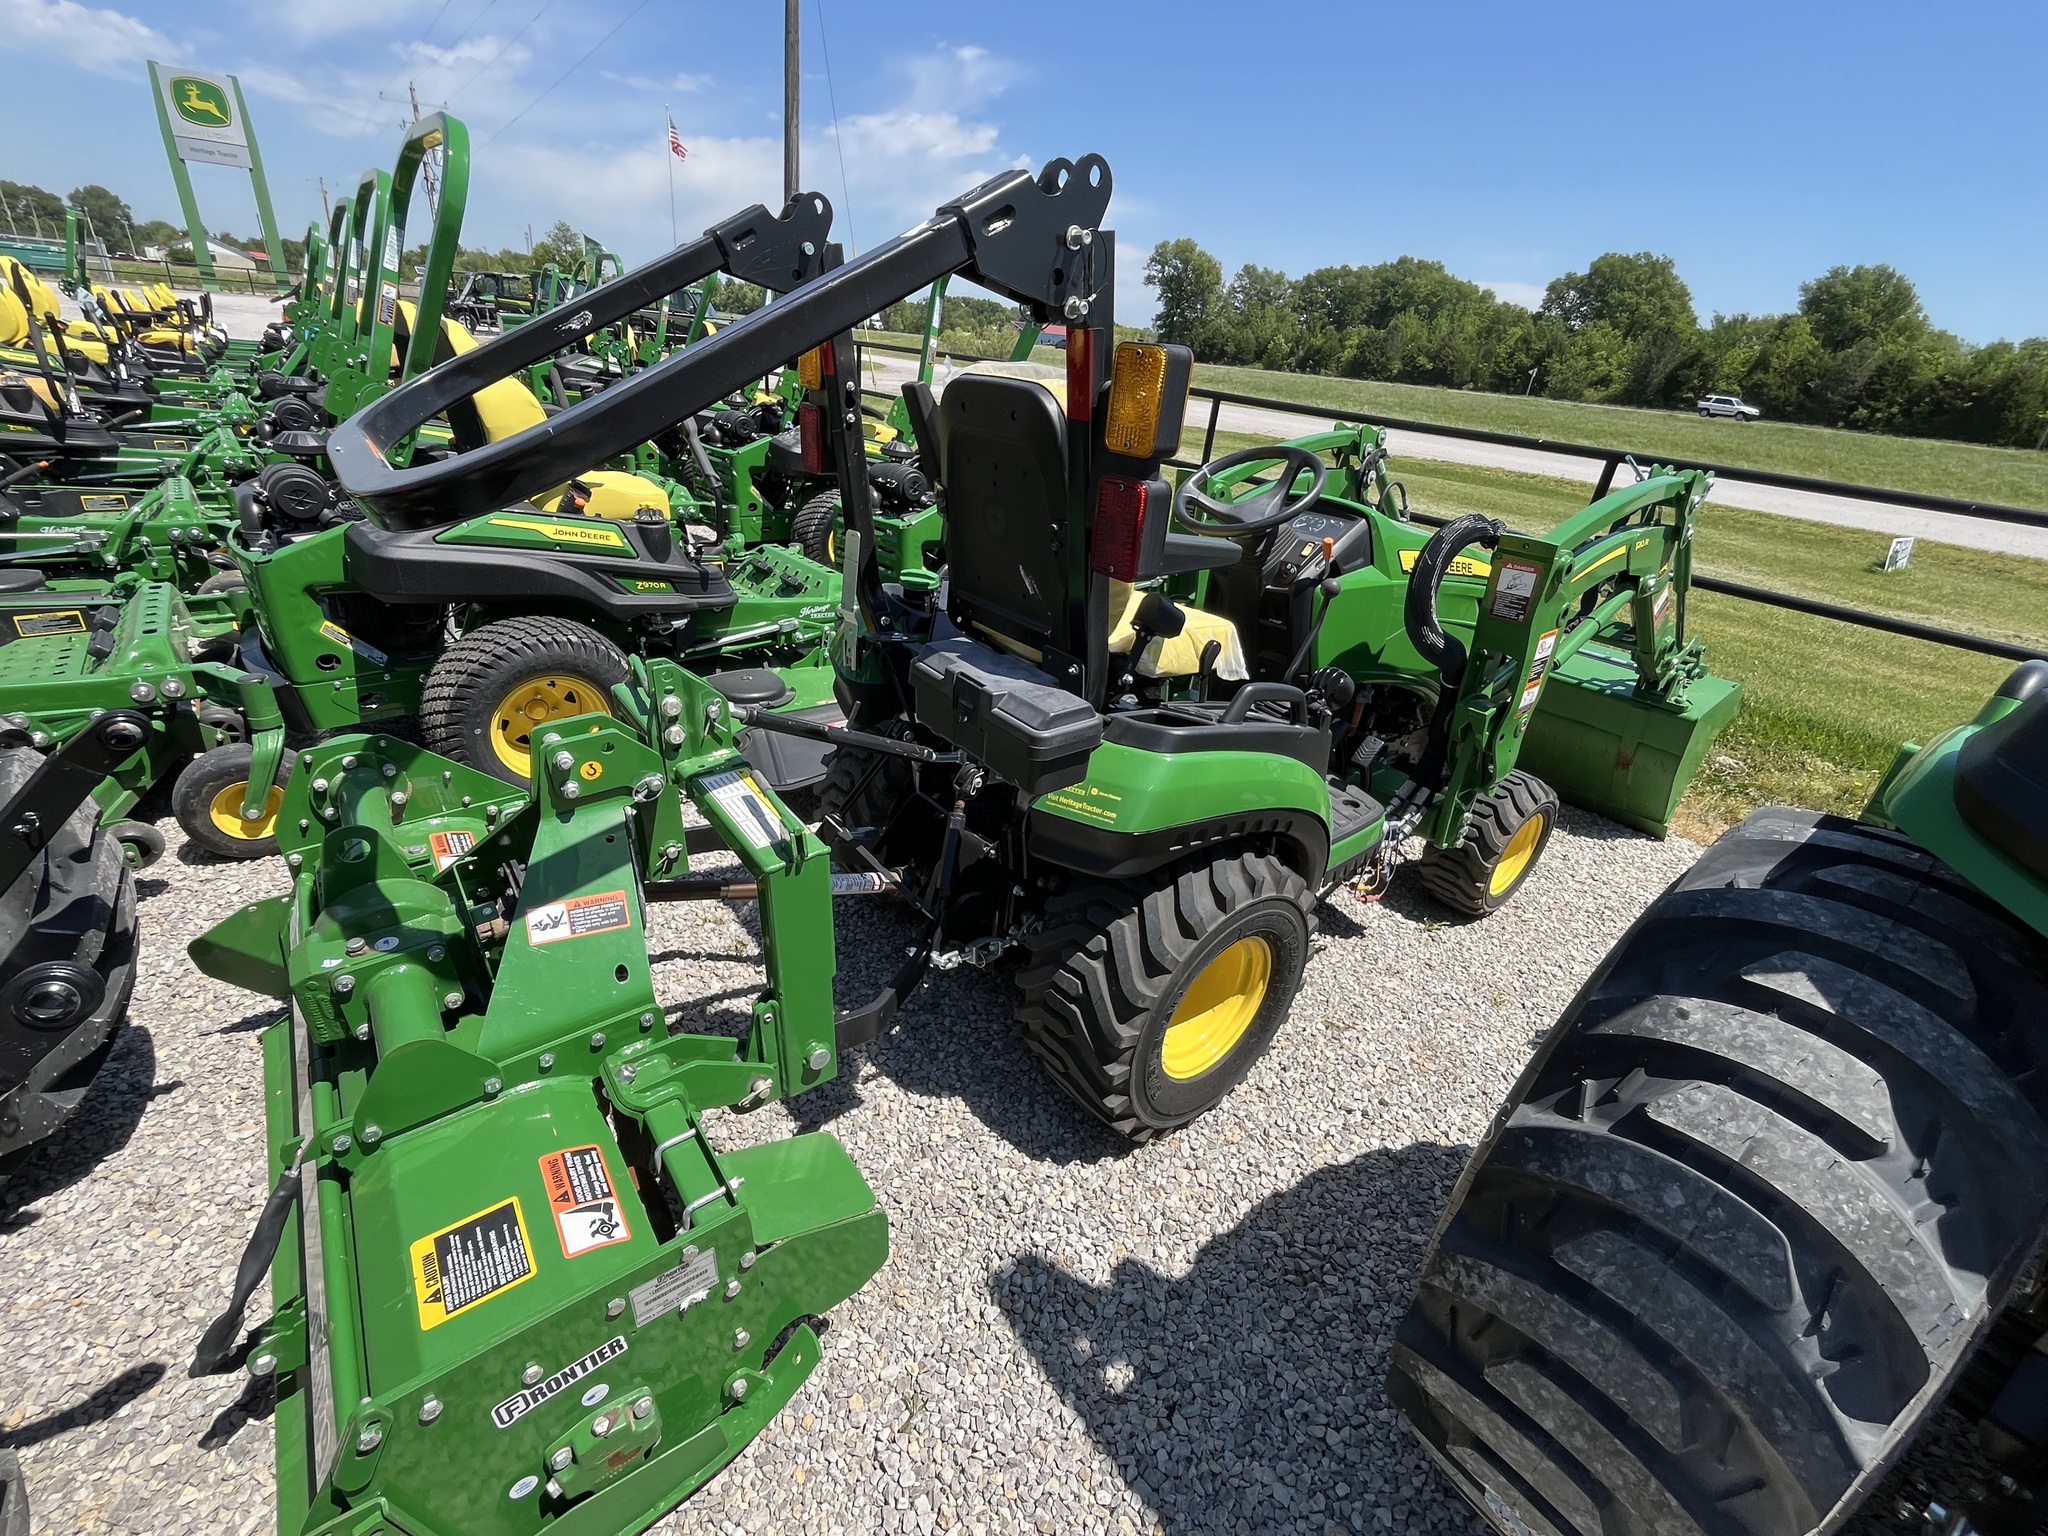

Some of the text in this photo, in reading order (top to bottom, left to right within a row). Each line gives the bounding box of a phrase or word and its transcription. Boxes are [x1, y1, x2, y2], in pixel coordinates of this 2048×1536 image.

[553, 527, 611, 541] JOHN DEERE
[1448, 561, 1473, 574] EERE
[635, 581, 667, 590] Z970R
[1058, 795, 1117, 819] HeritageTractor.com
[583, 896, 618, 906] WARNING
[548, 1158, 566, 1191] WARNING
[422, 1252, 439, 1289] CAUTION
[495, 1338, 624, 1426] FRONTIER
